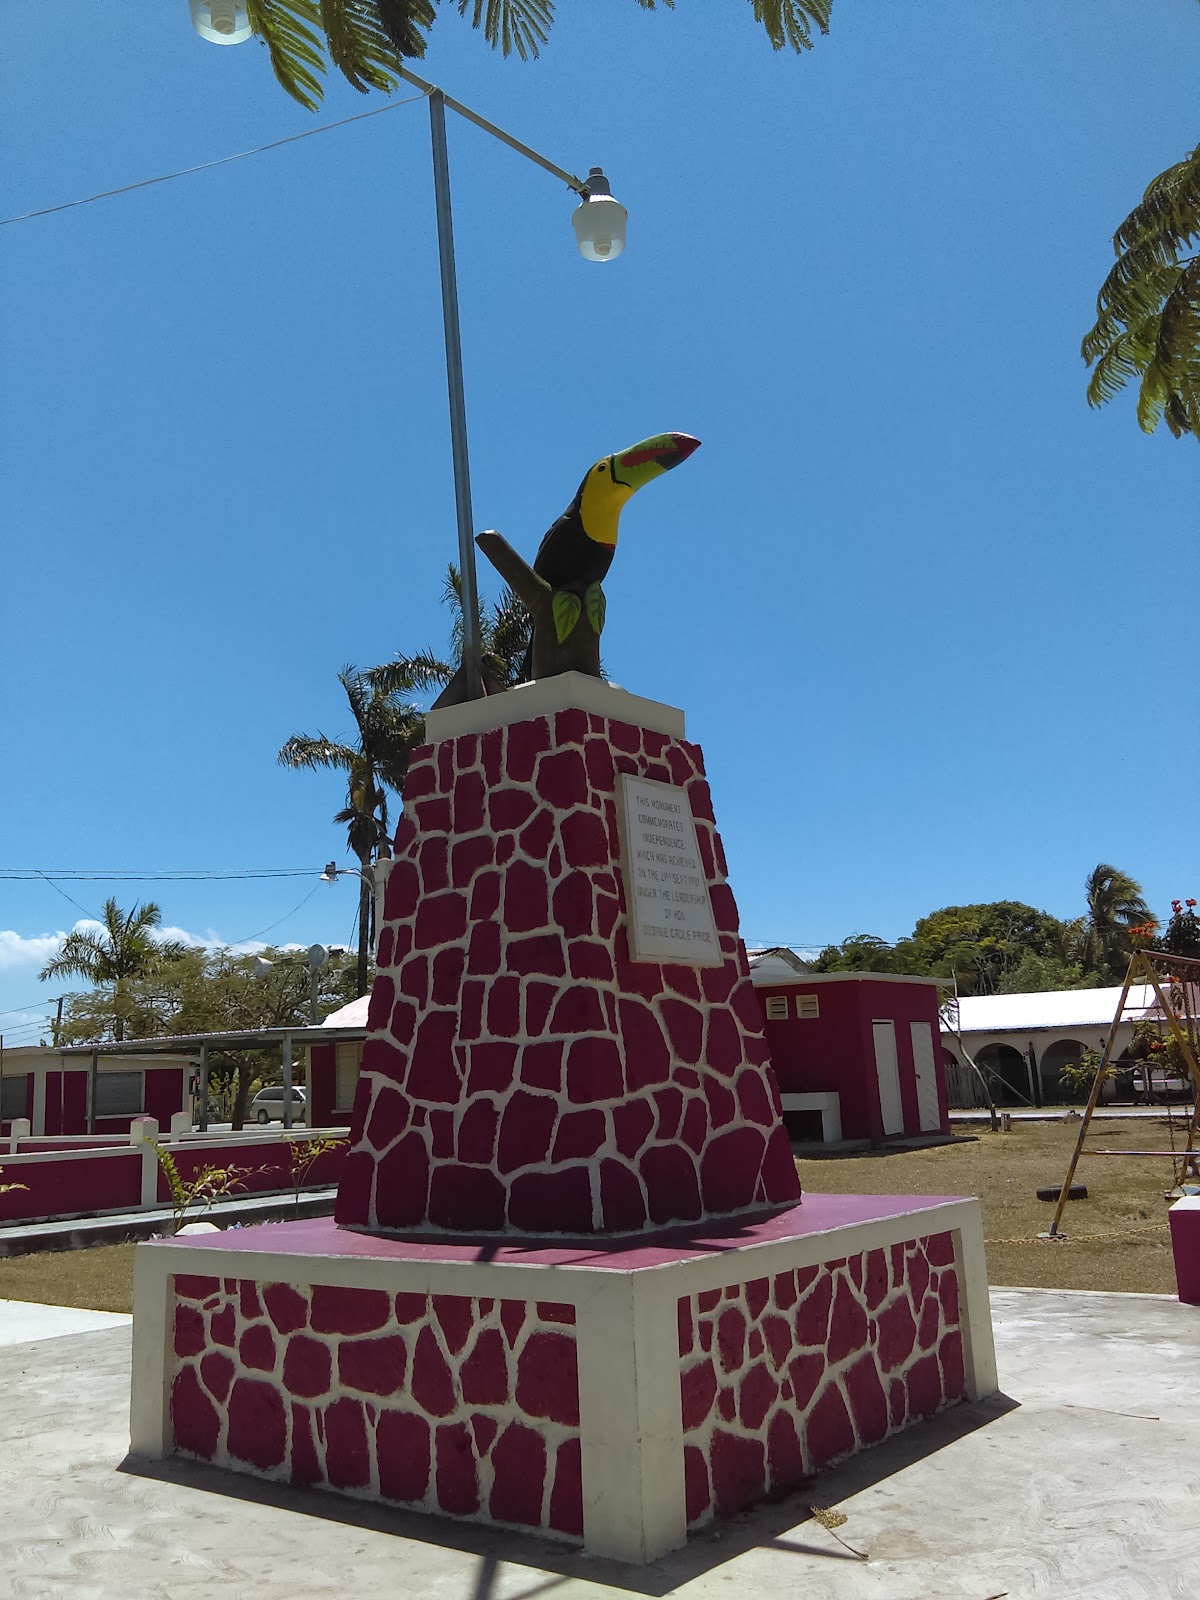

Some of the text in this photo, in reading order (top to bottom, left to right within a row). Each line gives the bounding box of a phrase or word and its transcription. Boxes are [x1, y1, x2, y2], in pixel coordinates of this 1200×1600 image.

[636, 796, 681, 814] THIS MONUMENT
[638, 813, 684, 832] COMMEMORATES
[642, 832, 685, 850] INDEPENDENCE
[637, 849, 696, 869] WHICH WAS ACHIEVED
[647, 869, 660, 881] THE
[637, 886, 706, 905] UNDER THE LEADERSHIP
[664, 908, 672, 919] OF
[642, 924, 669, 938] GEORGE
[692, 930, 712, 943] PRICE
